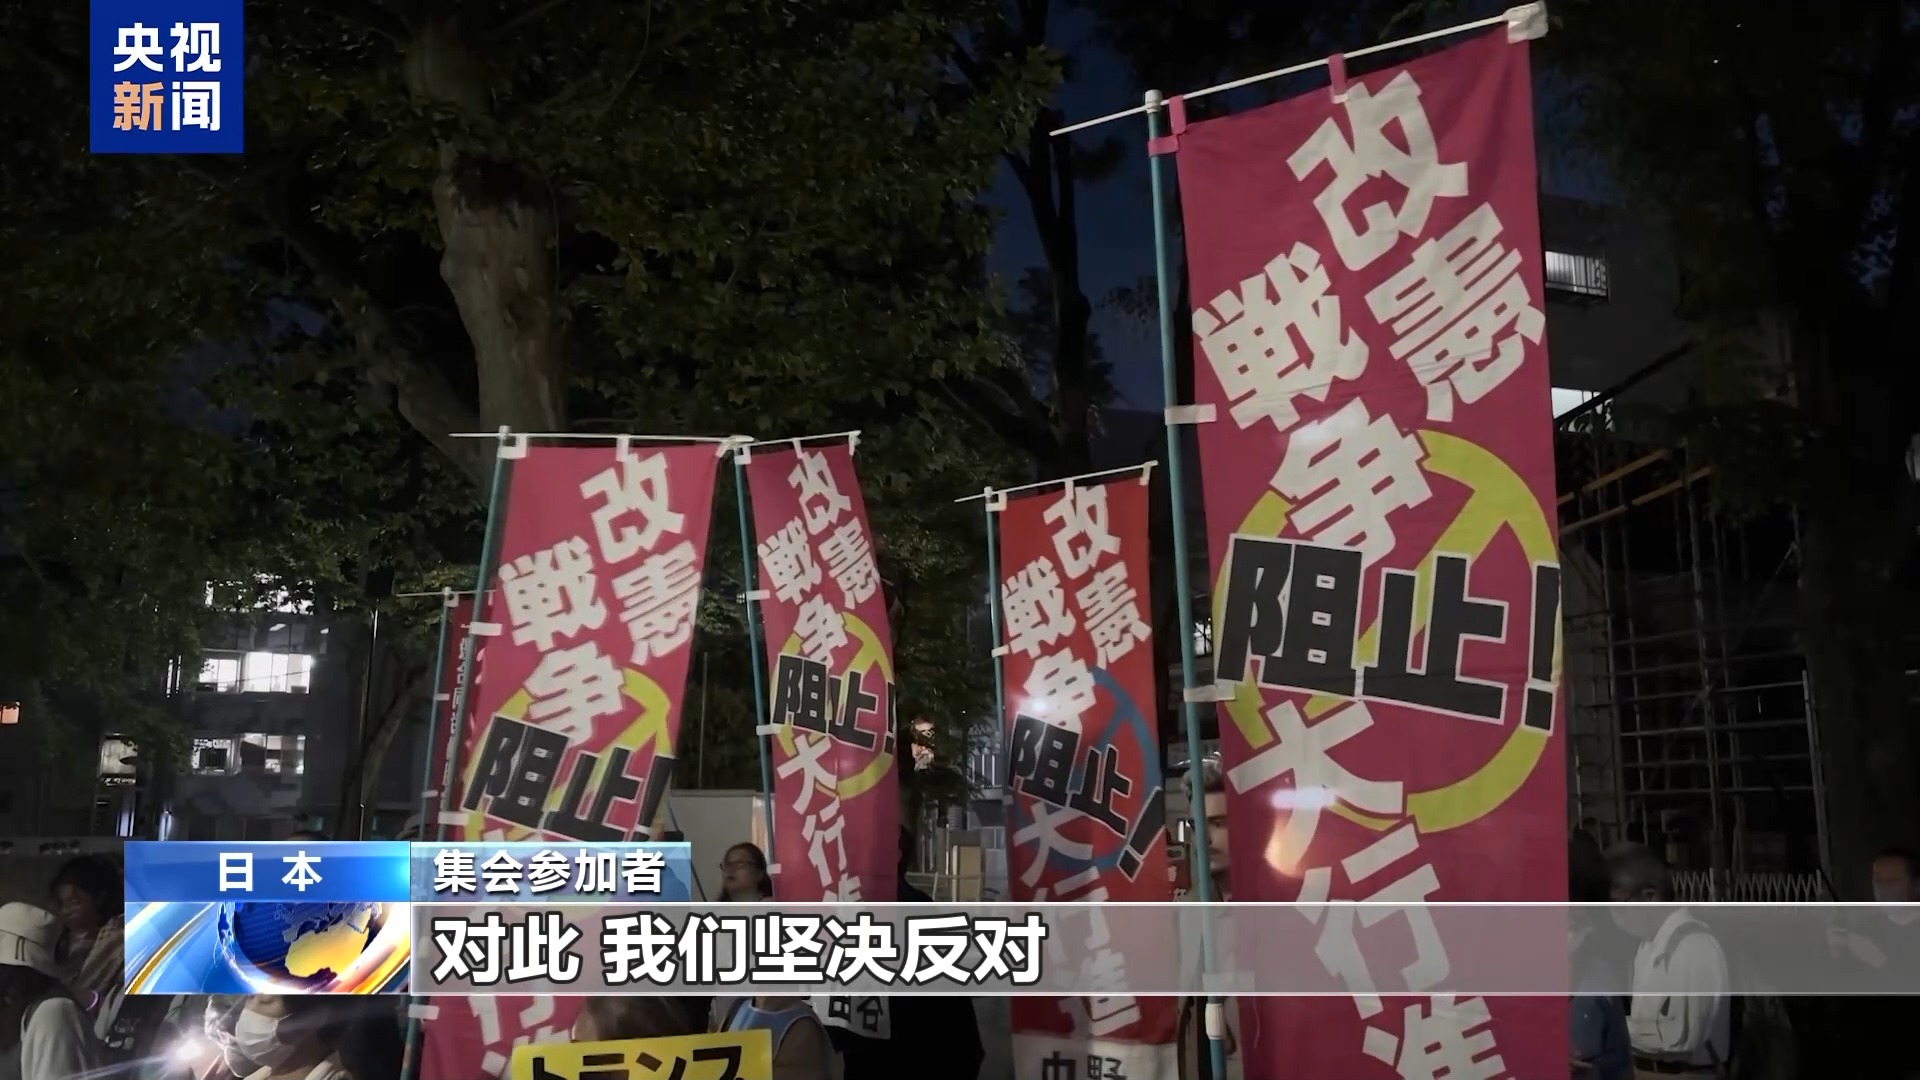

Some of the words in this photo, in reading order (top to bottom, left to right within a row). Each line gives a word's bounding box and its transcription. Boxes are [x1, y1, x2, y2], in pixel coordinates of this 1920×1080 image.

[1286, 70, 1546, 422] 改憲
[1192, 241, 1433, 566] 戦争
[580, 452, 701, 665] 改憲
[757, 516, 848, 669] 戦争
[788, 450, 881, 609] 改憲
[1043, 484, 1152, 669] 改憲
[499, 536, 625, 746] 戦争
[1001, 556, 1097, 734] 戦争
